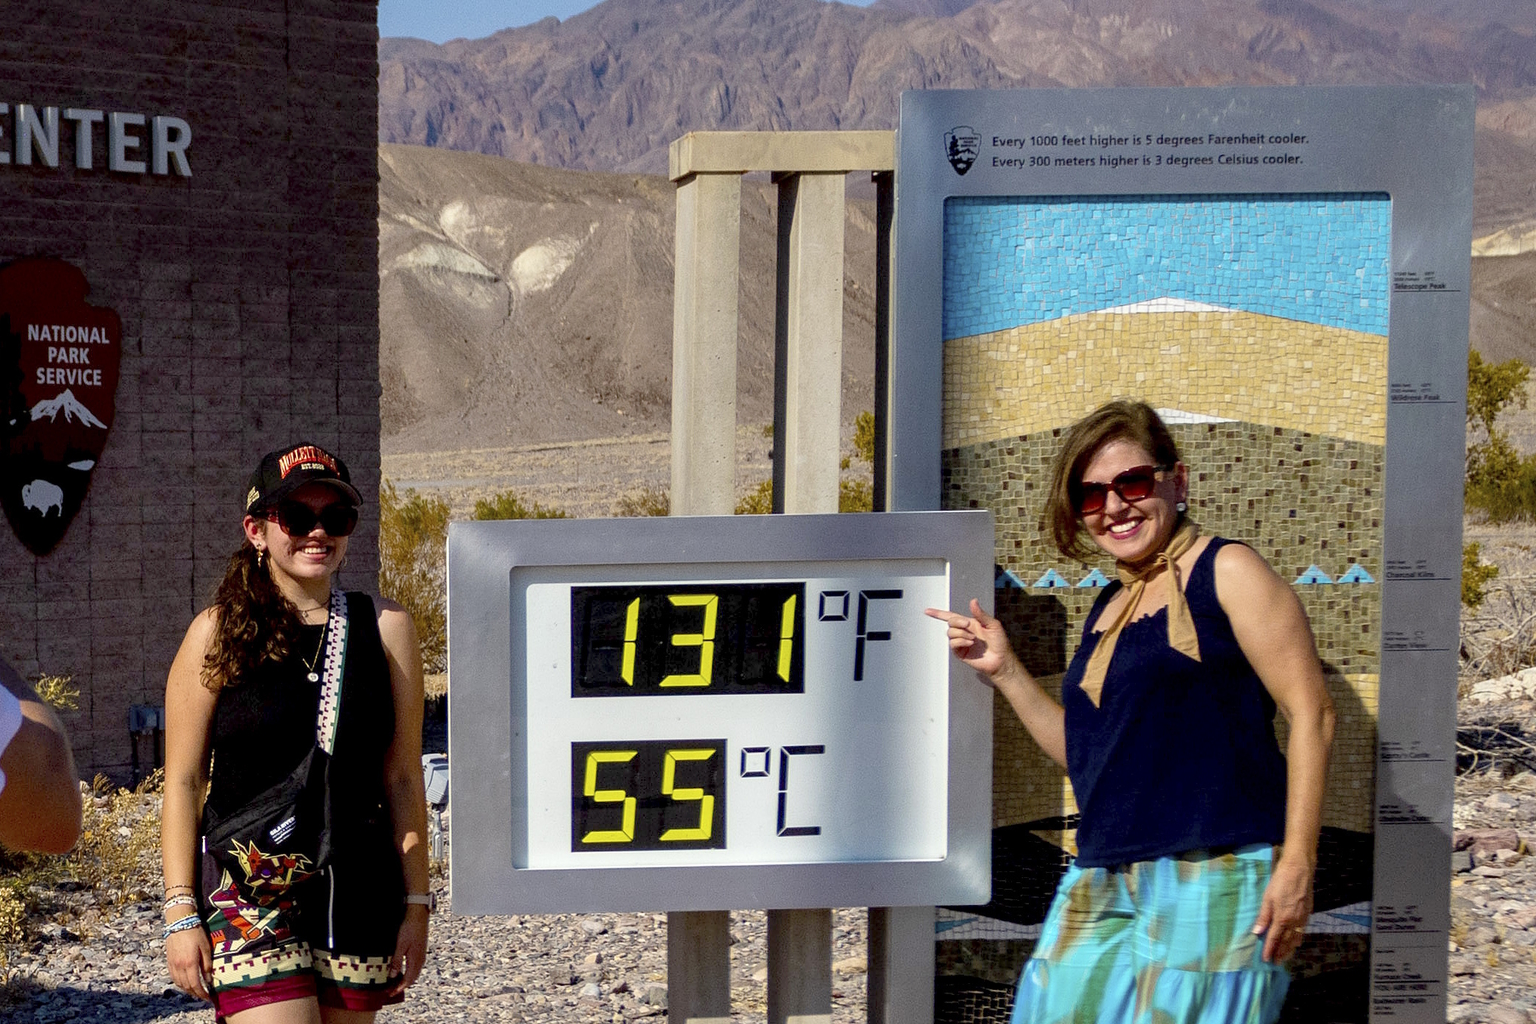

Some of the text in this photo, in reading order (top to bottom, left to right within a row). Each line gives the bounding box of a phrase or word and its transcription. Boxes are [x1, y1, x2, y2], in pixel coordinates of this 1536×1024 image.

[992, 136, 1025, 149] Every
[1030, 136, 1058, 146] 1000
[1062, 135, 1086, 146] feet
[1090, 134, 1128, 148] higher
[1132, 134, 1142, 145] is
[1146, 135, 1153, 145] 5
[1156, 134, 1204, 148] degrees
[1208, 134, 1264, 144] Farenheit
[1268, 133, 1310, 144] cooler.
[992, 153, 1304, 169] Every 300 meters higher is 3 degrees Celsius cooler.
[27, 324, 110, 344] NATIONAL
[48, 347, 90, 364] PARK
[36, 367, 102, 386] SERVICE
[620, 593, 798, 688] 131
[581, 747, 717, 844] 55
